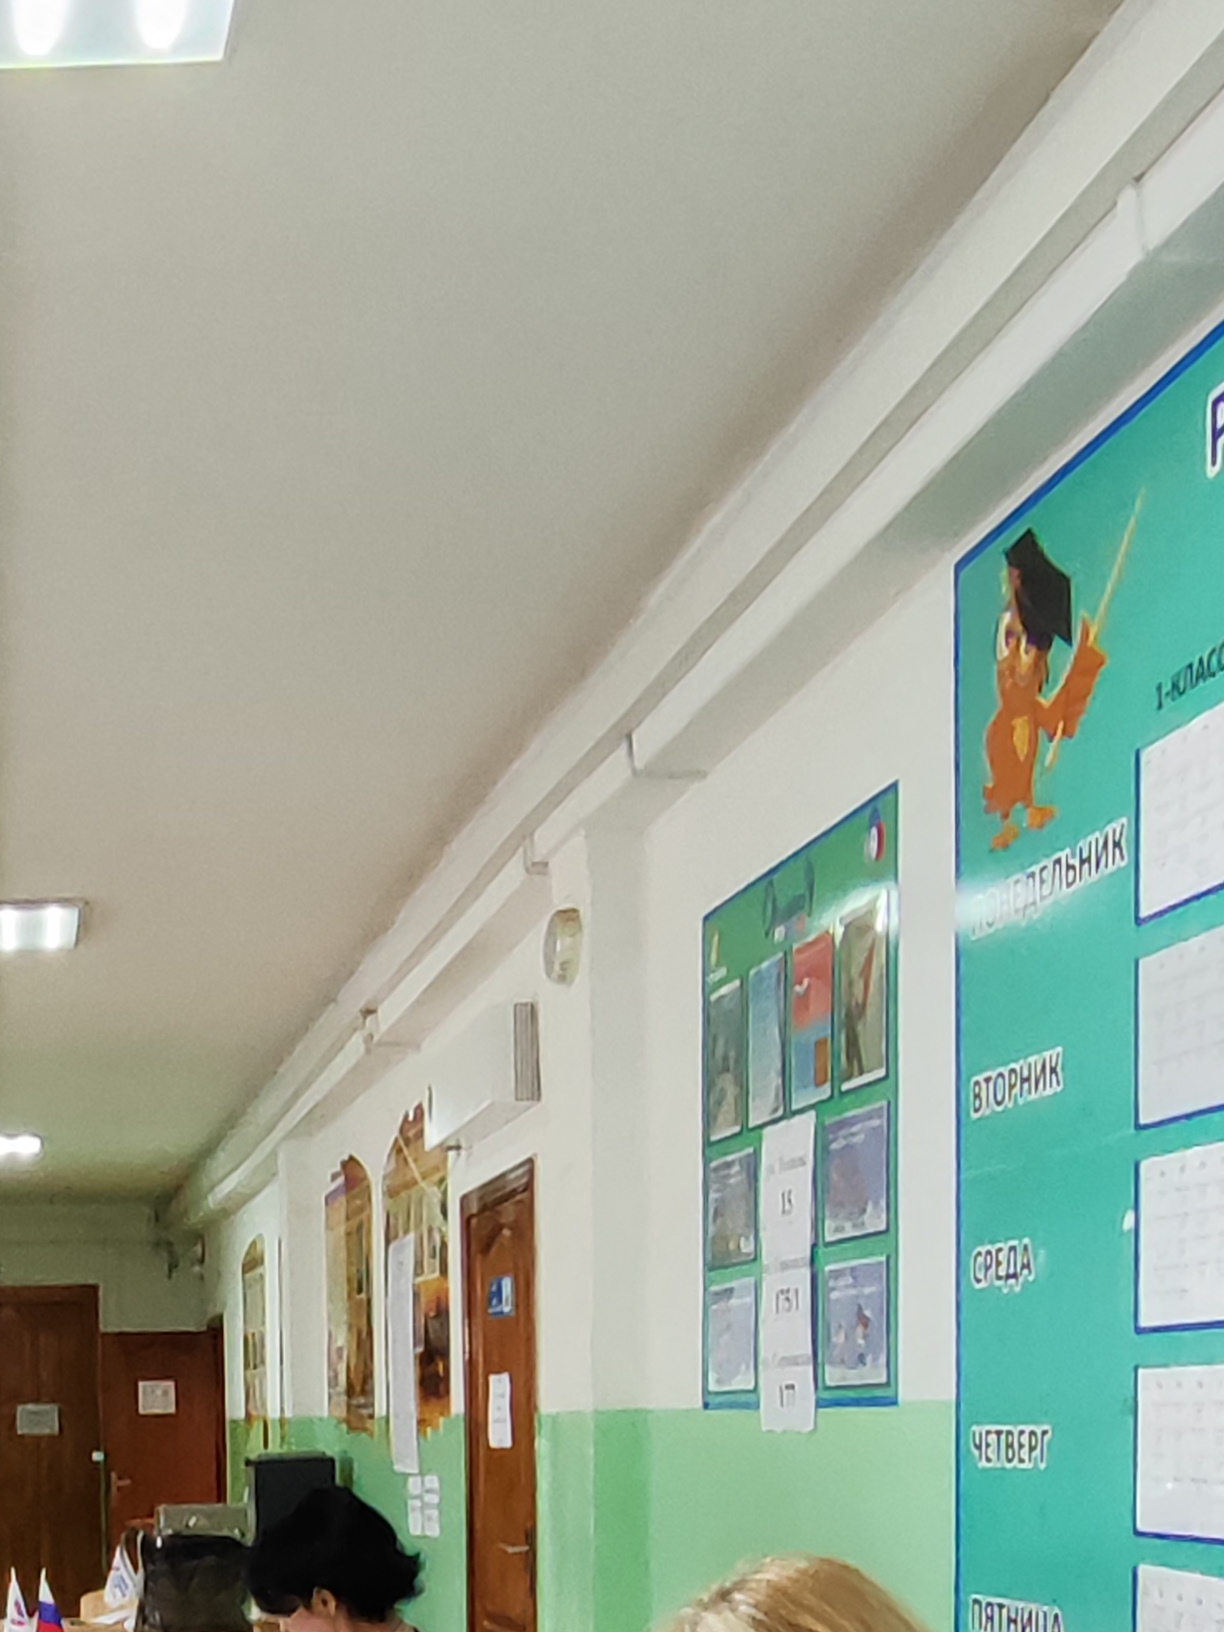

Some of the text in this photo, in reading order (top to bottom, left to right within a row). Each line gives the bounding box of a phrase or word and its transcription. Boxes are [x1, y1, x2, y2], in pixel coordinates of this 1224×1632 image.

[972, 1050, 1062, 1115] ВТОРНИК
[972, 1241, 1033, 1288] СРЕДА
[971, 1427, 1051, 1465] ЧЕТВЕРГ
